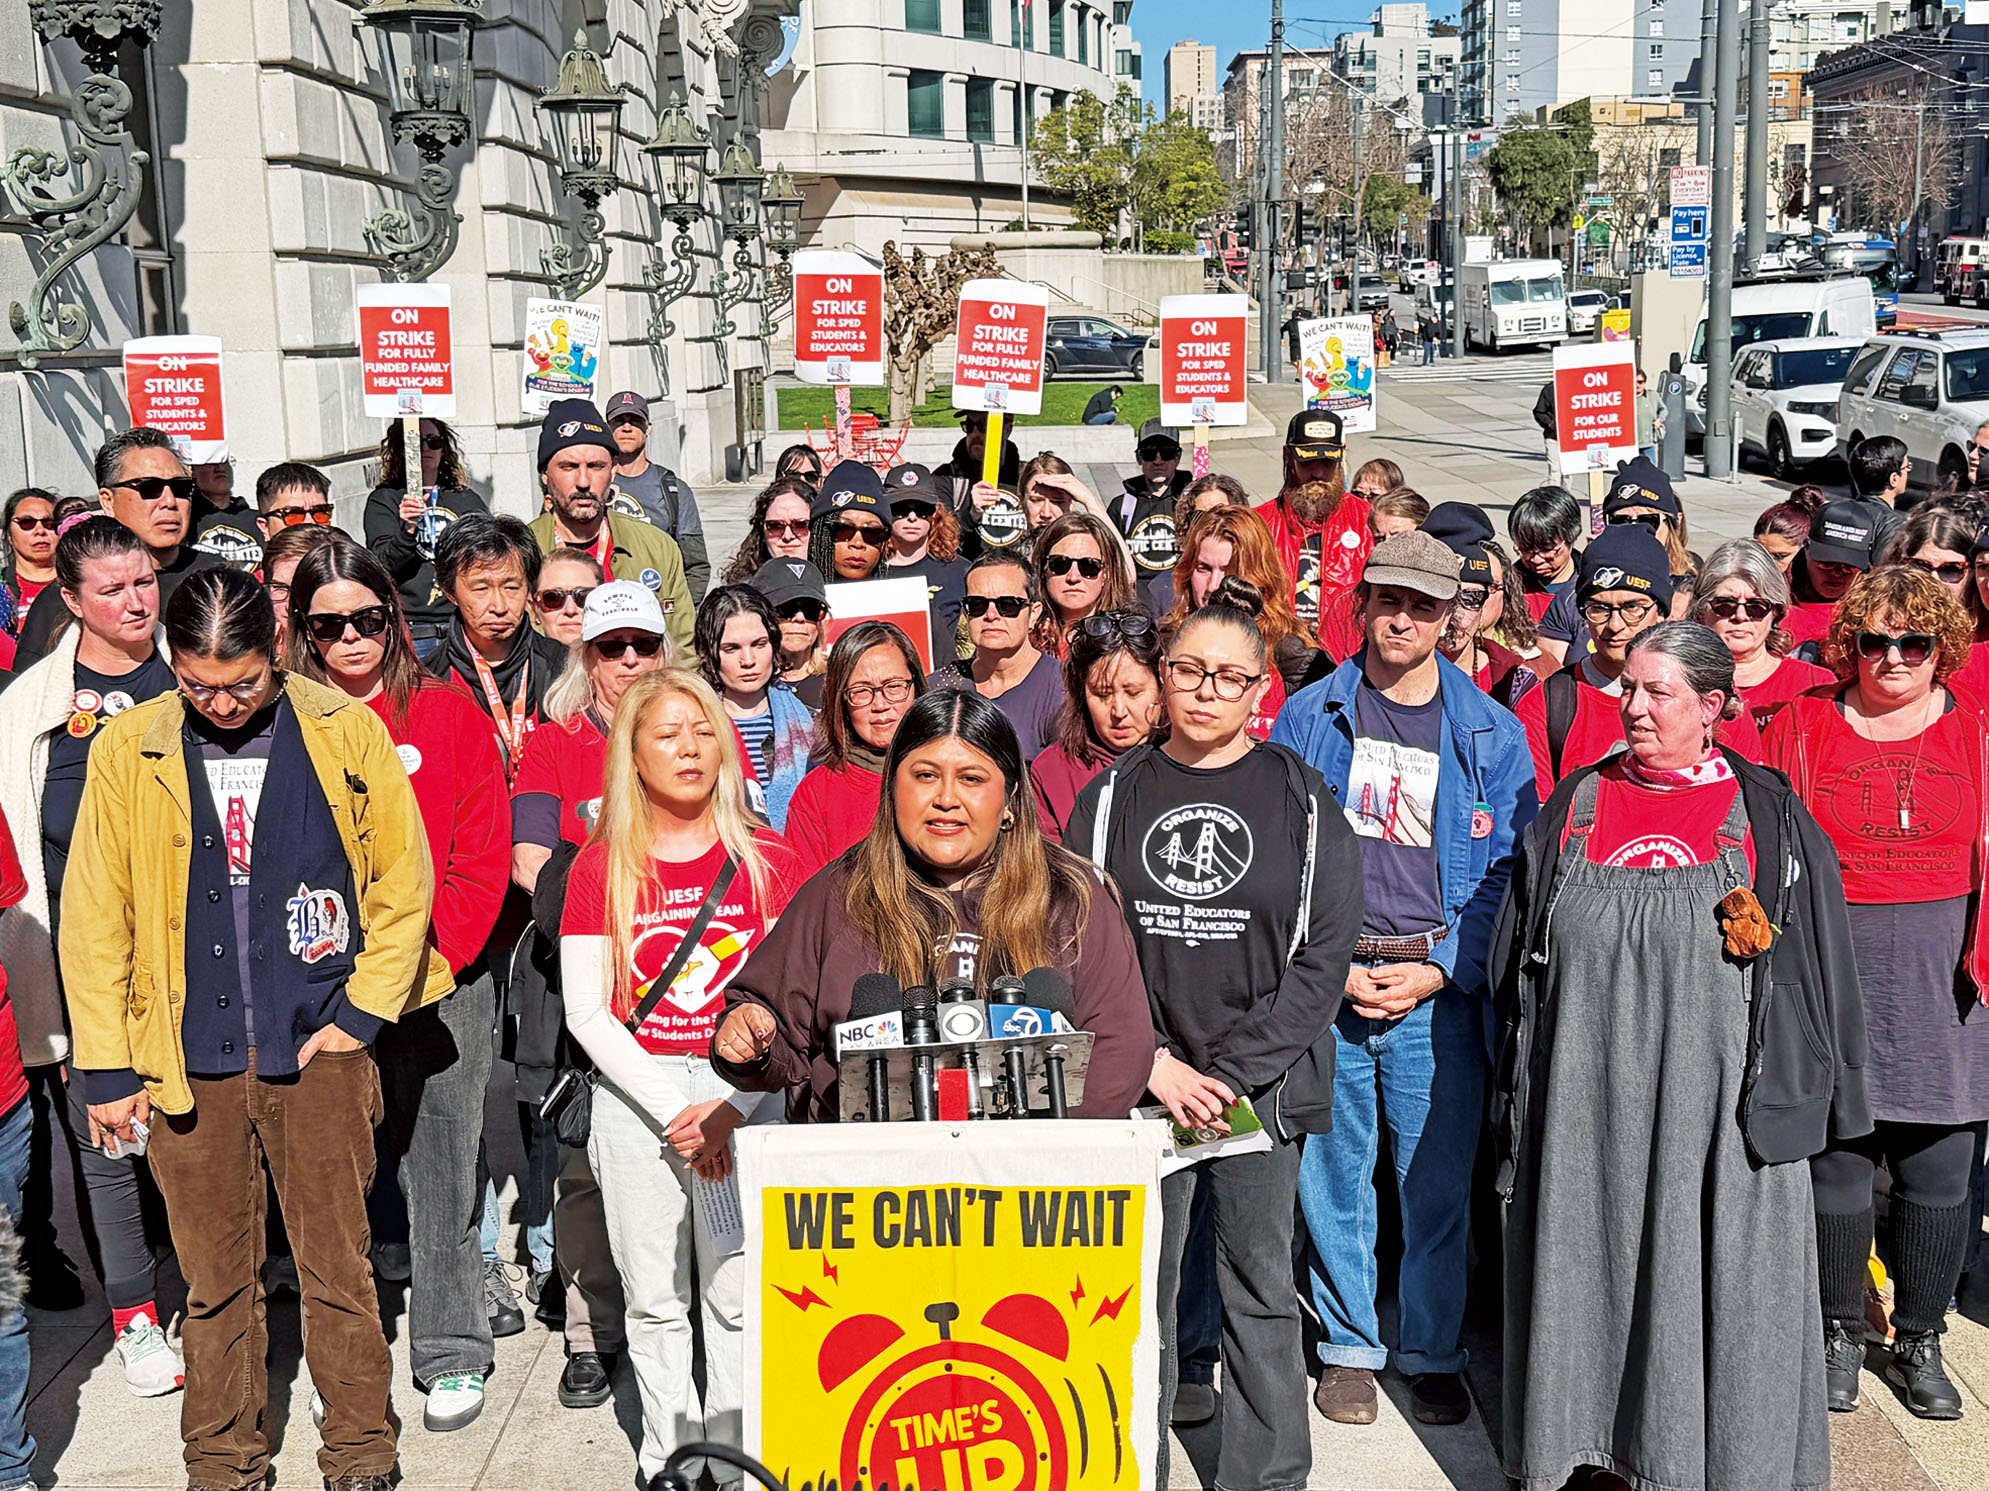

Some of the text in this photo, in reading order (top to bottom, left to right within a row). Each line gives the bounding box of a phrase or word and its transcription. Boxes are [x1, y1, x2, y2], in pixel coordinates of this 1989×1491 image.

[1673, 208, 1705, 219] Pay here
[1672, 245, 1696, 254] Pay by
[1672, 252, 1697, 260] License
[826, 278, 852, 293] ON
[547, 304, 573, 314] CAN'T
[575, 307, 600, 323] WAIT!
[812, 300, 867, 315] STRIKE
[989, 304, 1016, 320] ON
[391, 309, 419, 324] ON
[817, 318, 861, 328] FOR SPED
[811, 330, 867, 340] STUDENTS &
[973, 324, 1028, 343] STRIKE
[1191, 321, 1217, 336] ON
[1302, 321, 1370, 338] WE CAN'T WAIT!
[377, 331, 435, 346] STRIKE
[378, 348, 436, 359] FOR FULLY
[810, 343, 865, 352] EDUCATORS
[972, 341, 1028, 355] FOR FULLY
[1177, 342, 1230, 357] STRIKE
[158, 356, 187, 371] ON
[365, 362, 450, 373] FUNDED FAMILY
[958, 354, 1040, 370] FUNDED FAMILY
[1182, 360, 1225, 370] FOR SPED
[373, 377, 444, 387] HEALTHCARE
[963, 369, 1031, 384] HEALTHCARE
[1176, 372, 1231, 382] STUDENTS &
[1583, 371, 1608, 388] ON
[144, 378, 205, 393] STRIKE
[1175, 384, 1230, 394] EDUCATORS
[151, 397, 199, 406] FOR SPED
[1570, 391, 1622, 409] STRIKE
[146, 409, 207, 419] STUDENTS &
[1574, 413, 1619, 426] FOR OUR
[146, 422, 206, 431] EDUCATORS
[1572, 427, 1622, 440] STUDENTS
[1626, 575, 1652, 591] UESF
[1161, 808, 1240, 833] ORGANIZE
[1860, 821, 1933, 838] RESIST
[1885, 848, 1960, 859] EDUCATORS
[1855, 861, 1881, 871] SAN
[1885, 861, 1955, 871] FRANCISCO
[1164, 873, 1222, 895] RESIST
[715, 904, 744, 917] EAM
[1134, 900, 1251, 920] UNITED EDUCATORS
[1156, 915, 1180, 929] SAN
[1183, 917, 1246, 932] FRANCISCO
[672, 1013, 688, 1026] for
[691, 1015, 710, 1024] the
[1003, 1019, 1021, 1032] abc
[1012, 1007, 1042, 1036] 7
[652, 1028, 702, 1040] Students
[840, 1024, 874, 1044] NBC
[784, 1192, 855, 1250] WE
[873, 1188, 1003, 1249] CAN'T
[1019, 1190, 1131, 1248] WAIT
[890, 1399, 1003, 1451] TIME'S
[895, 1439, 1025, 1491] UP
